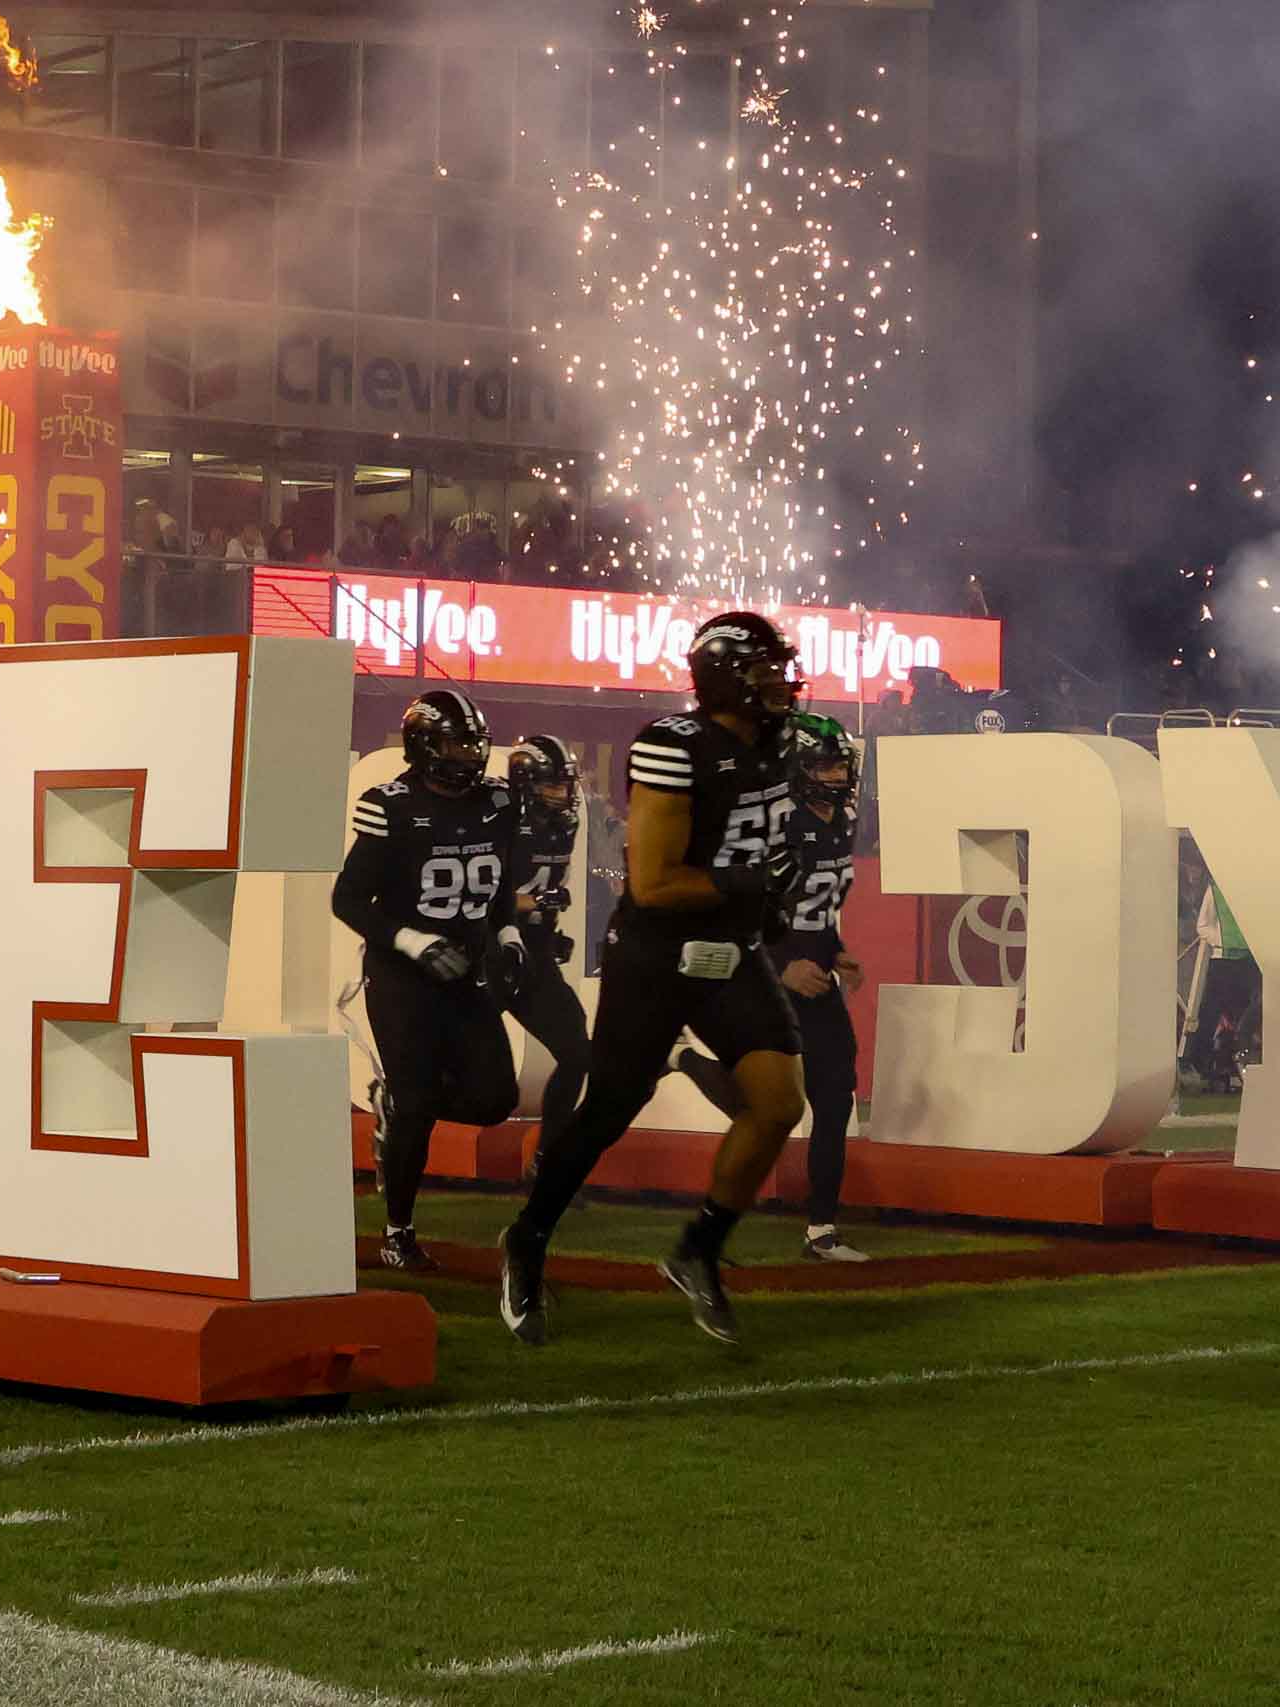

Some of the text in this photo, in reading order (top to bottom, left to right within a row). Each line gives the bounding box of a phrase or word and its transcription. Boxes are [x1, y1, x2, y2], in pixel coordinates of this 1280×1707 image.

[277, 334, 559, 422] Chevron
[39, 414, 117, 446] STATE
[417, 854, 502, 920] 89
